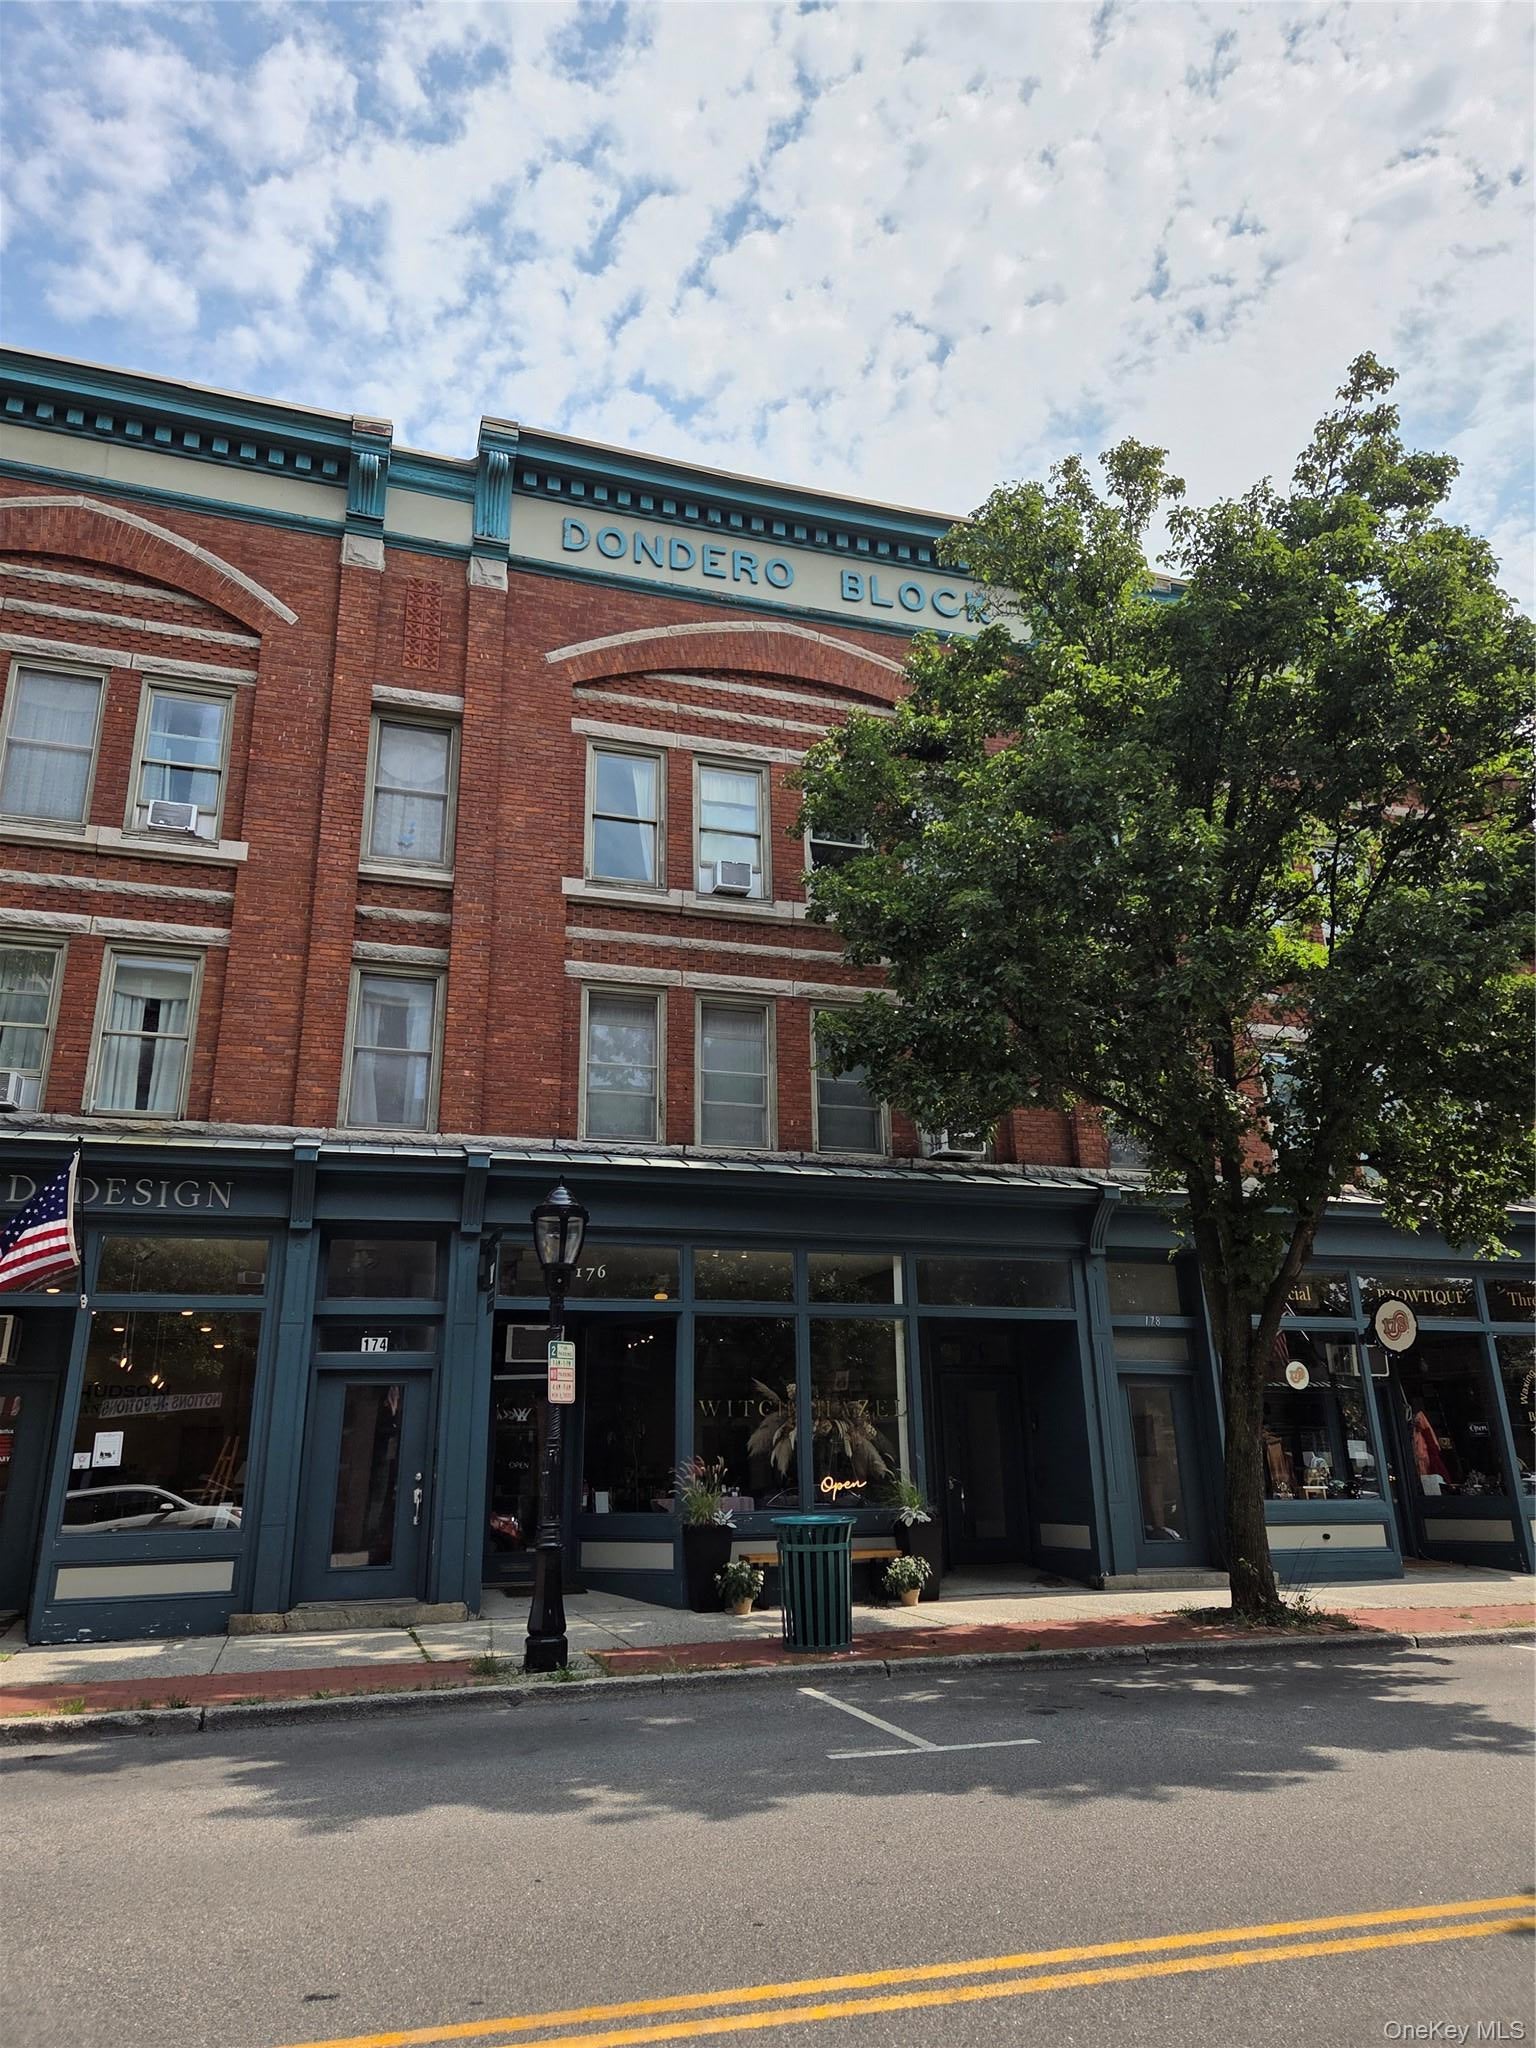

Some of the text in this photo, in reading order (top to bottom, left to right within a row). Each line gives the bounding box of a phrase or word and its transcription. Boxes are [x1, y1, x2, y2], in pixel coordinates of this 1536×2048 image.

[562, 517, 992, 625] DONDERO BLOCK
[73, 1176, 235, 1209] DESIGN
[575, 1263, 607, 1282] 176
[1145, 1315, 1161, 1328] 178
[363, 1338, 387, 1352] 174
[551, 1345, 557, 1356] 2
[698, 1400, 796, 1417] WITCH
[1469, 1424, 1488, 1432] Open
[820, 1475, 867, 1501] Open
